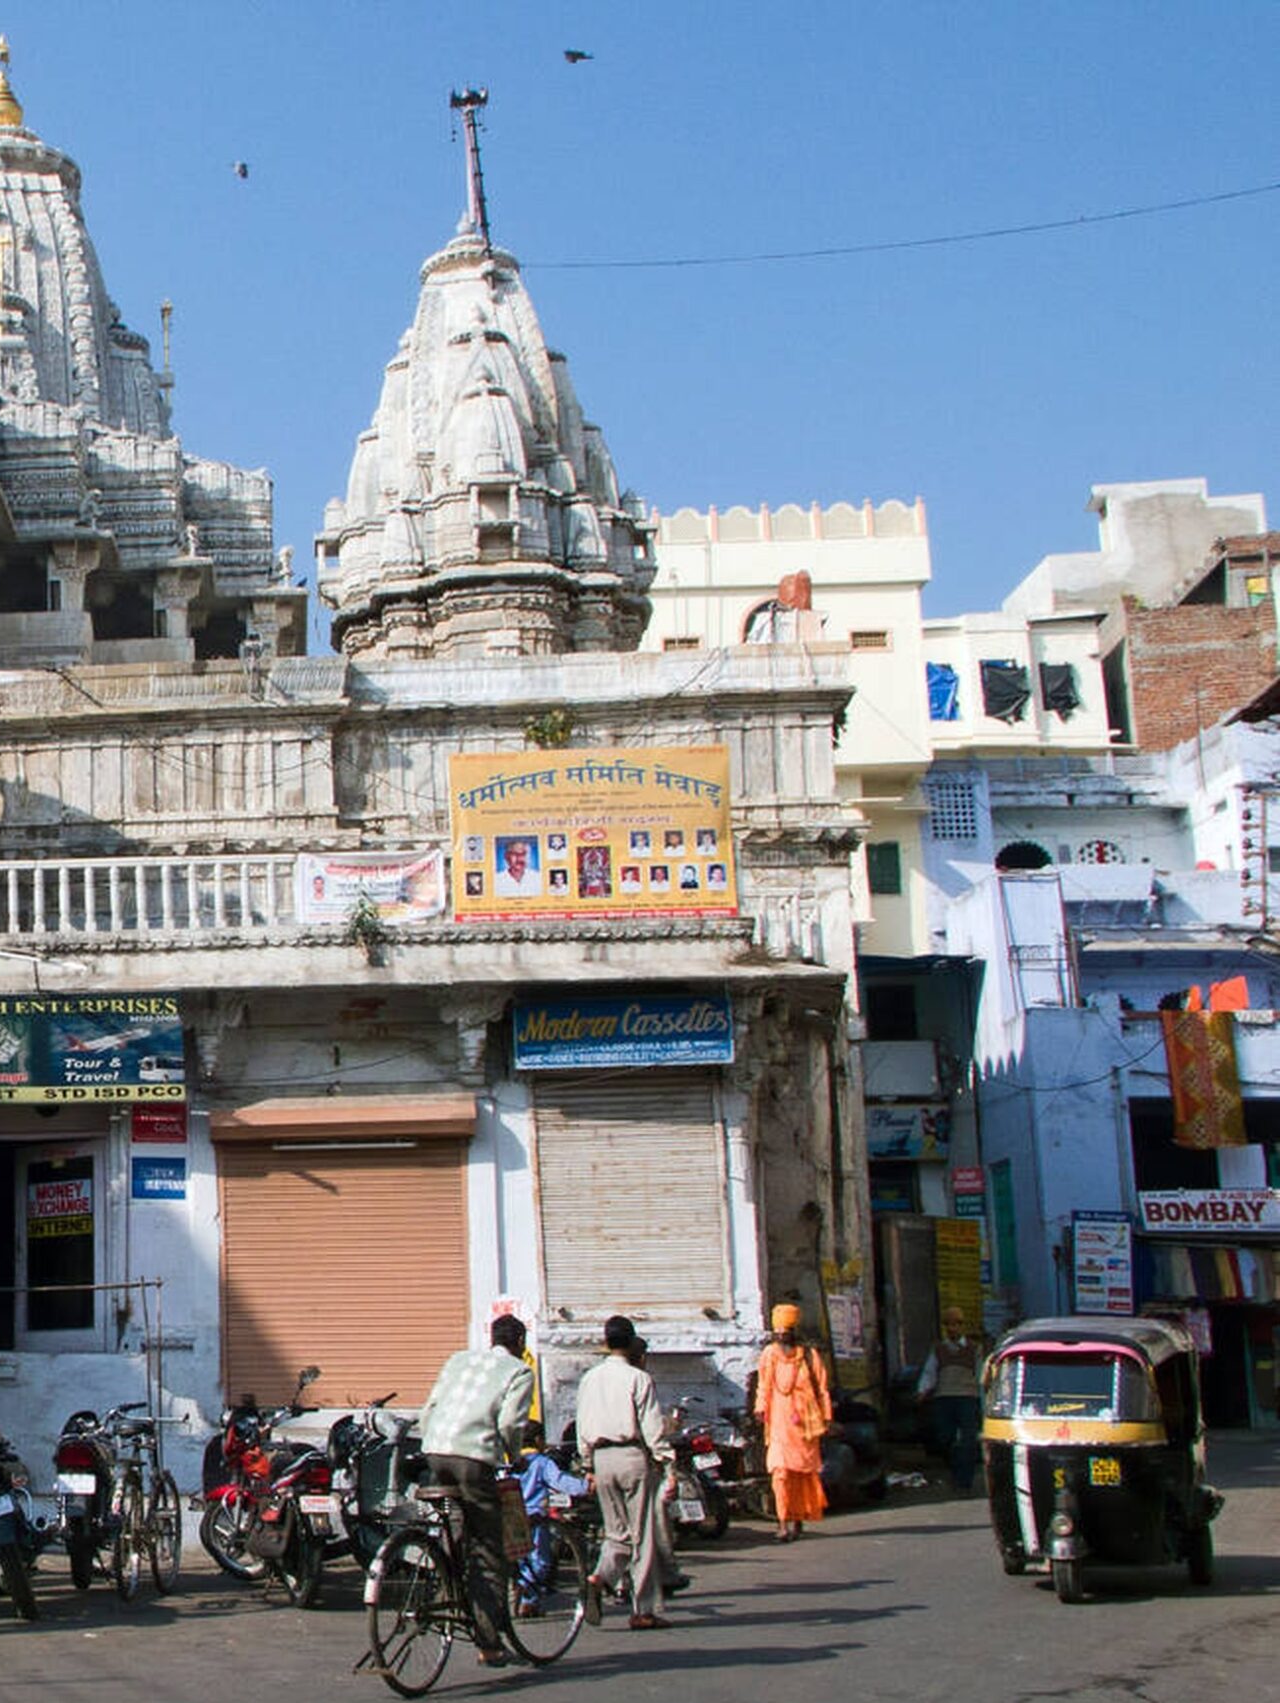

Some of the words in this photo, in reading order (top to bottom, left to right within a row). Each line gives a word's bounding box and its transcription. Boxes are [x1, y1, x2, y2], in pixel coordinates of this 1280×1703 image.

[15, 997, 179, 1015] ENTERPRISES
[519, 1008, 619, 1042] Modern
[622, 1002, 729, 1036] Cassettes
[64, 1058, 102, 1069] Tour
[109, 1058, 122, 1069] &
[65, 1071, 119, 1083] Travel
[44, 1087, 86, 1099] STD
[94, 1087, 130, 1098] ISD
[137, 1086, 183, 1097] PCO
[35, 1182, 83, 1200] MONEY
[1144, 1201, 1266, 1222] BOMBAY
